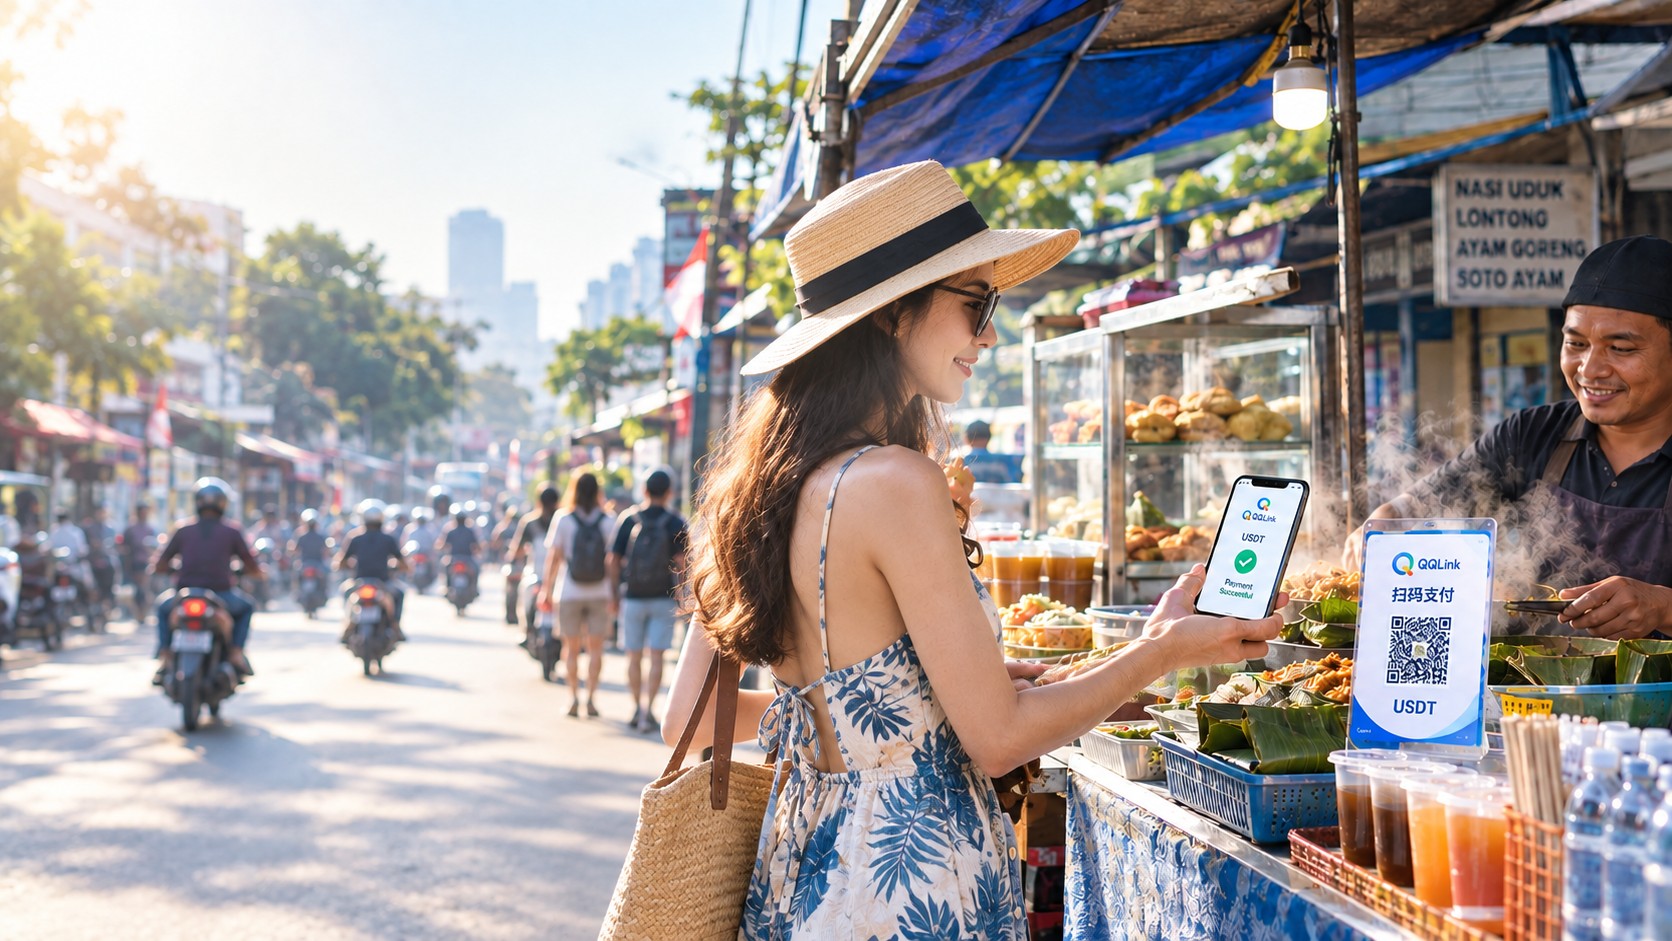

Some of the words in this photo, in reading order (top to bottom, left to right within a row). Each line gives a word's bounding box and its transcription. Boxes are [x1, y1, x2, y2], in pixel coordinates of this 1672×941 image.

[1456, 179, 1502, 198] NASI
[1508, 180, 1564, 199] UDUK
[1457, 208, 1548, 228] LONTONG
[1457, 240, 1507, 258] AYAM
[1511, 239, 1586, 259] GORENG
[1457, 268, 1507, 289] SOTO
[1512, 270, 1564, 289] AYAM
[1241, 533, 1266, 544] USDT
[1418, 558, 1461, 571] QQLink
[1391, 587, 1455, 603] 扫码支付
[1393, 698, 1437, 715] USDT
